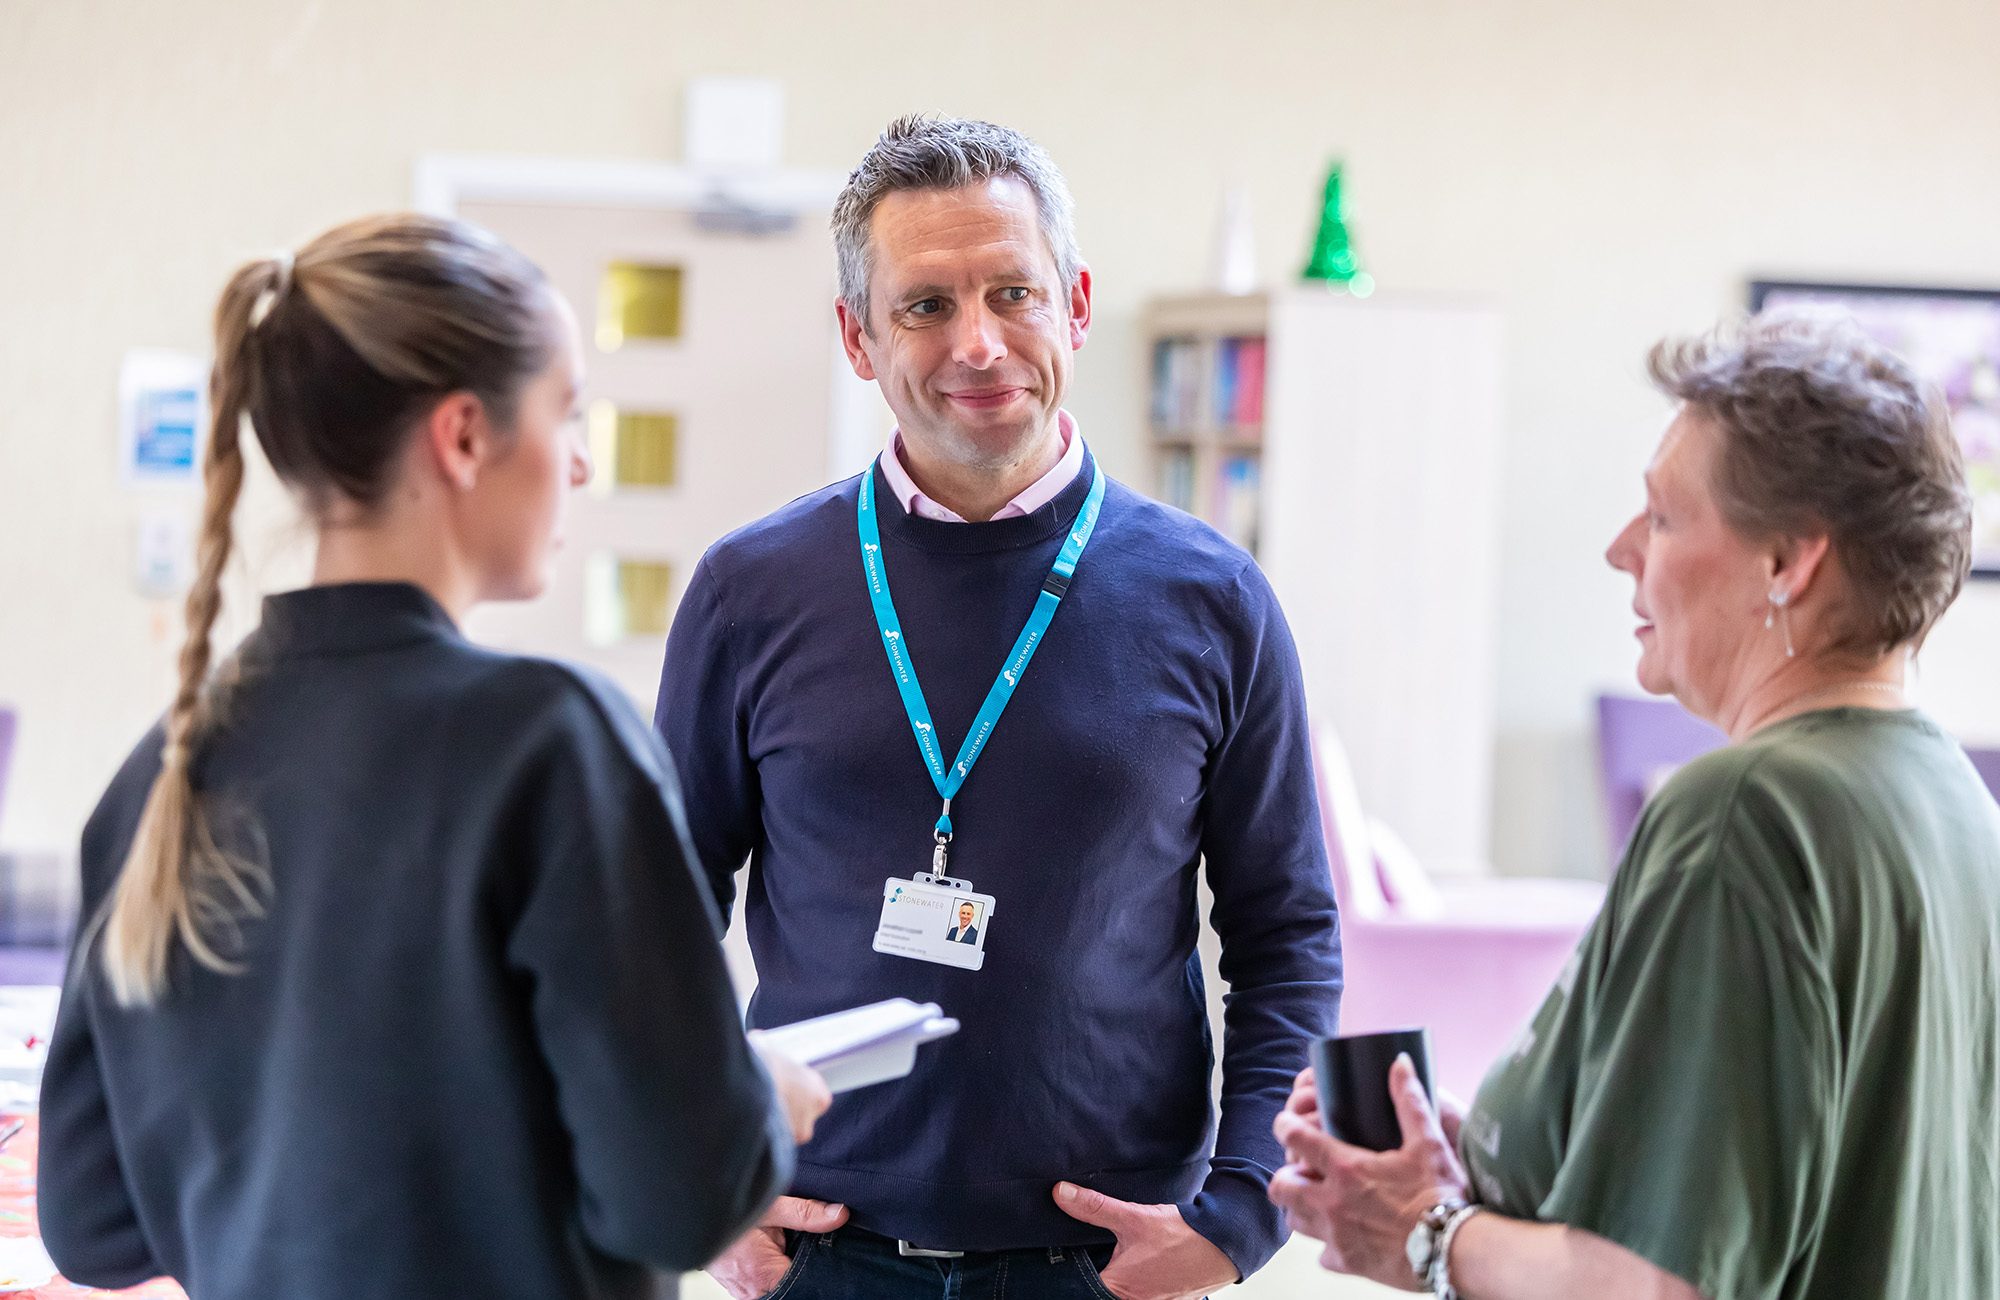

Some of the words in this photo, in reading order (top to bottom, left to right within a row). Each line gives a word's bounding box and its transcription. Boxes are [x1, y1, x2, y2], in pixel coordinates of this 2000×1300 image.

[867, 550, 881, 594] STONEWATER
[888, 638, 908, 684] STONEWATER
[1011, 631, 1037, 676] STONEWATER
[920, 729, 942, 775] STONEWATER
[964, 721, 990, 767] STONEWATER
[898, 895, 945, 910] STONEWATER
